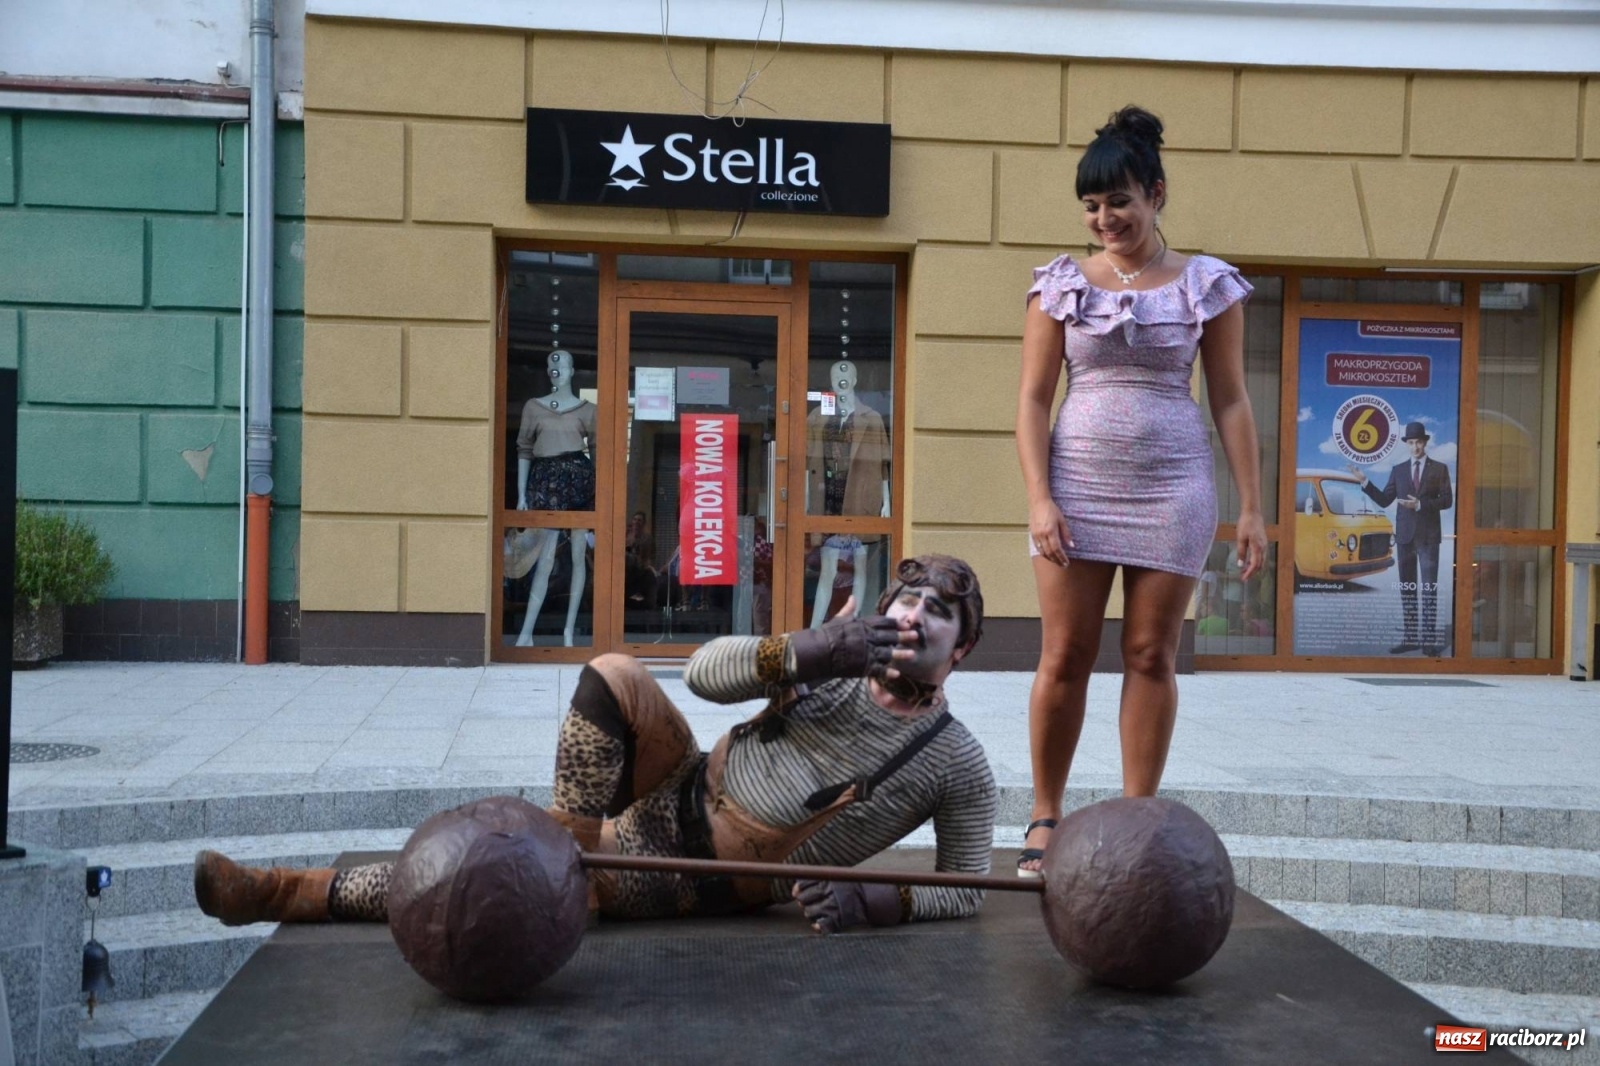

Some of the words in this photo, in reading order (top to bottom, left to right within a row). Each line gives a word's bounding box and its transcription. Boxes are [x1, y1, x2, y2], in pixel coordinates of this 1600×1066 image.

[662, 133, 821, 188] Stella
[760, 190, 819, 203] collezione
[1334, 359, 1423, 371] MAKROPRZYGODA
[1339, 372, 1417, 383] MIKROKOSZTEM
[1350, 408, 1379, 451] 6
[695, 419, 724, 475] NOWA
[694, 481, 723, 579] KOLEKCJA
[1391, 581, 1417, 591] RRSO
[1420, 582, 1446, 592] 13,7
